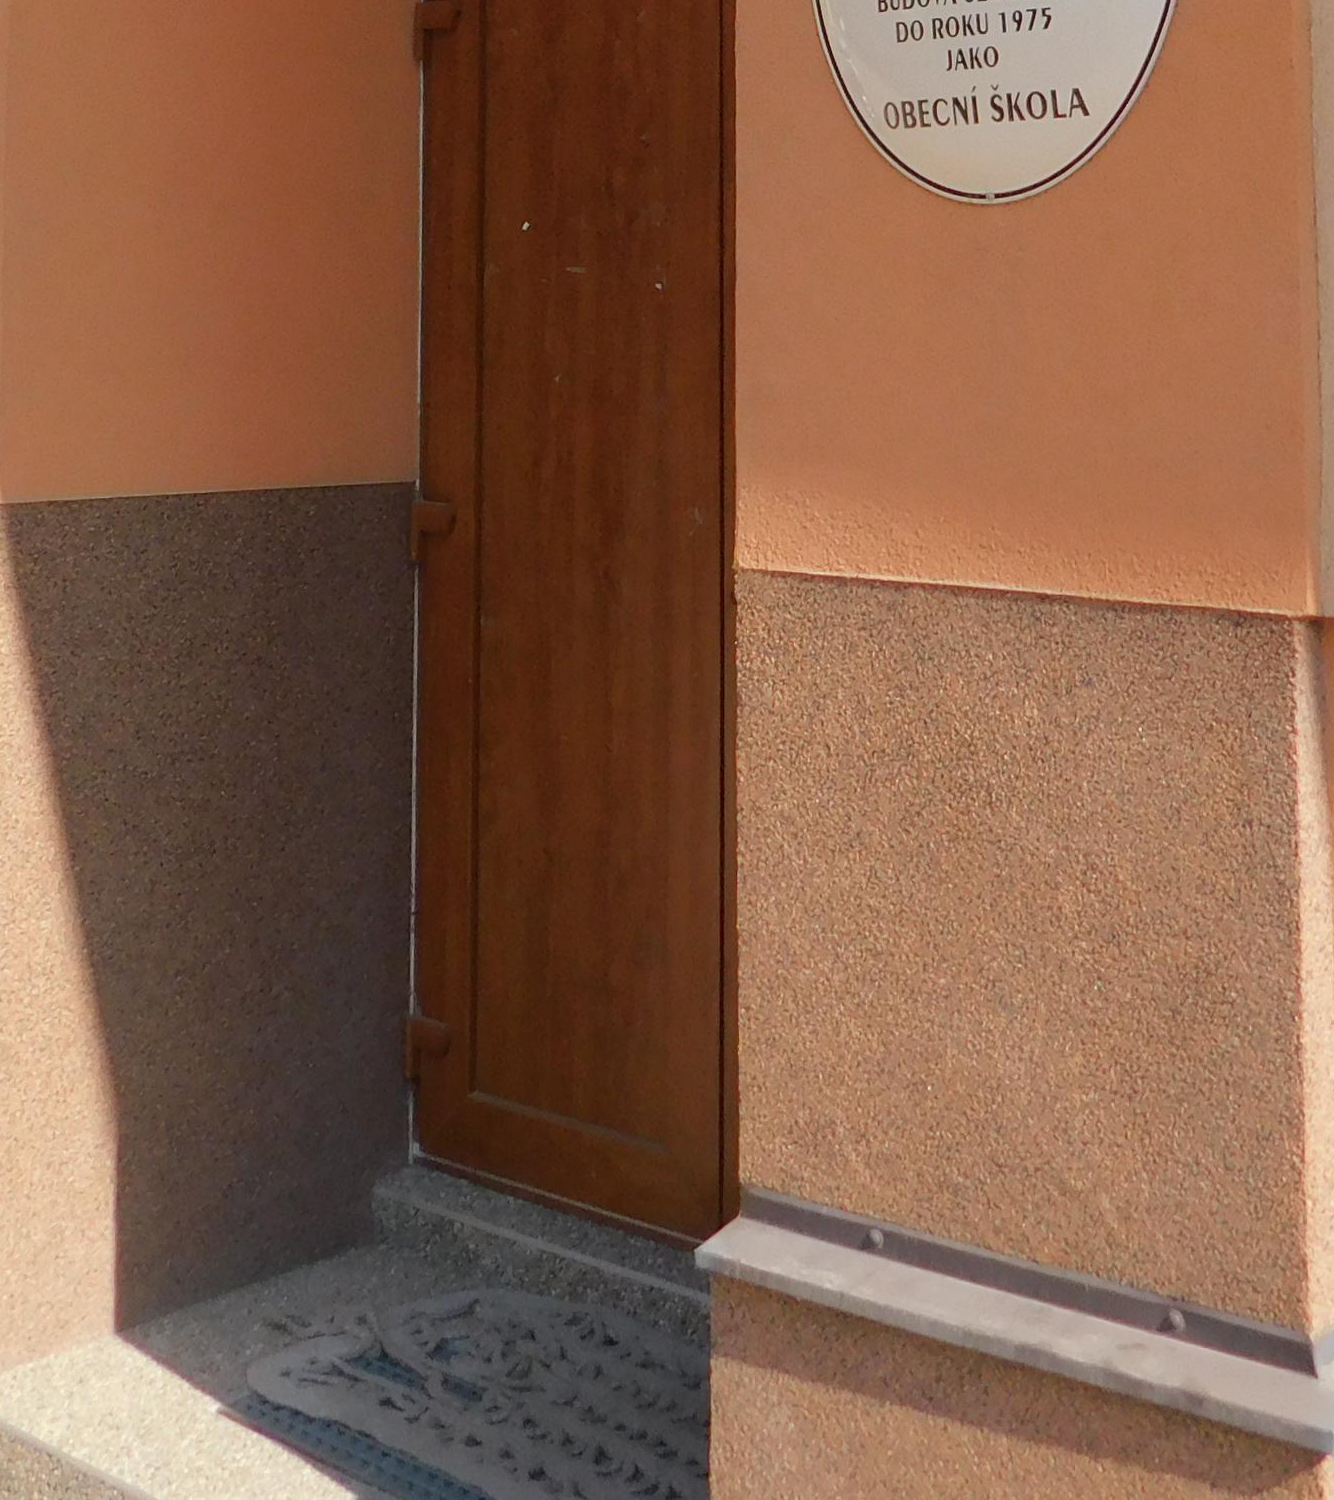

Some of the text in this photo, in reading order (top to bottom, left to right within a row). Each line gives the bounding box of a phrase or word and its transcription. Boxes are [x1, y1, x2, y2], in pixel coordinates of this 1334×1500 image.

[895, 8, 1053, 44] DO ROKU 1975
[945, 45, 1000, 72] JAKO
[882, 84, 1090, 130] OBECNÍ ŠKOLA
